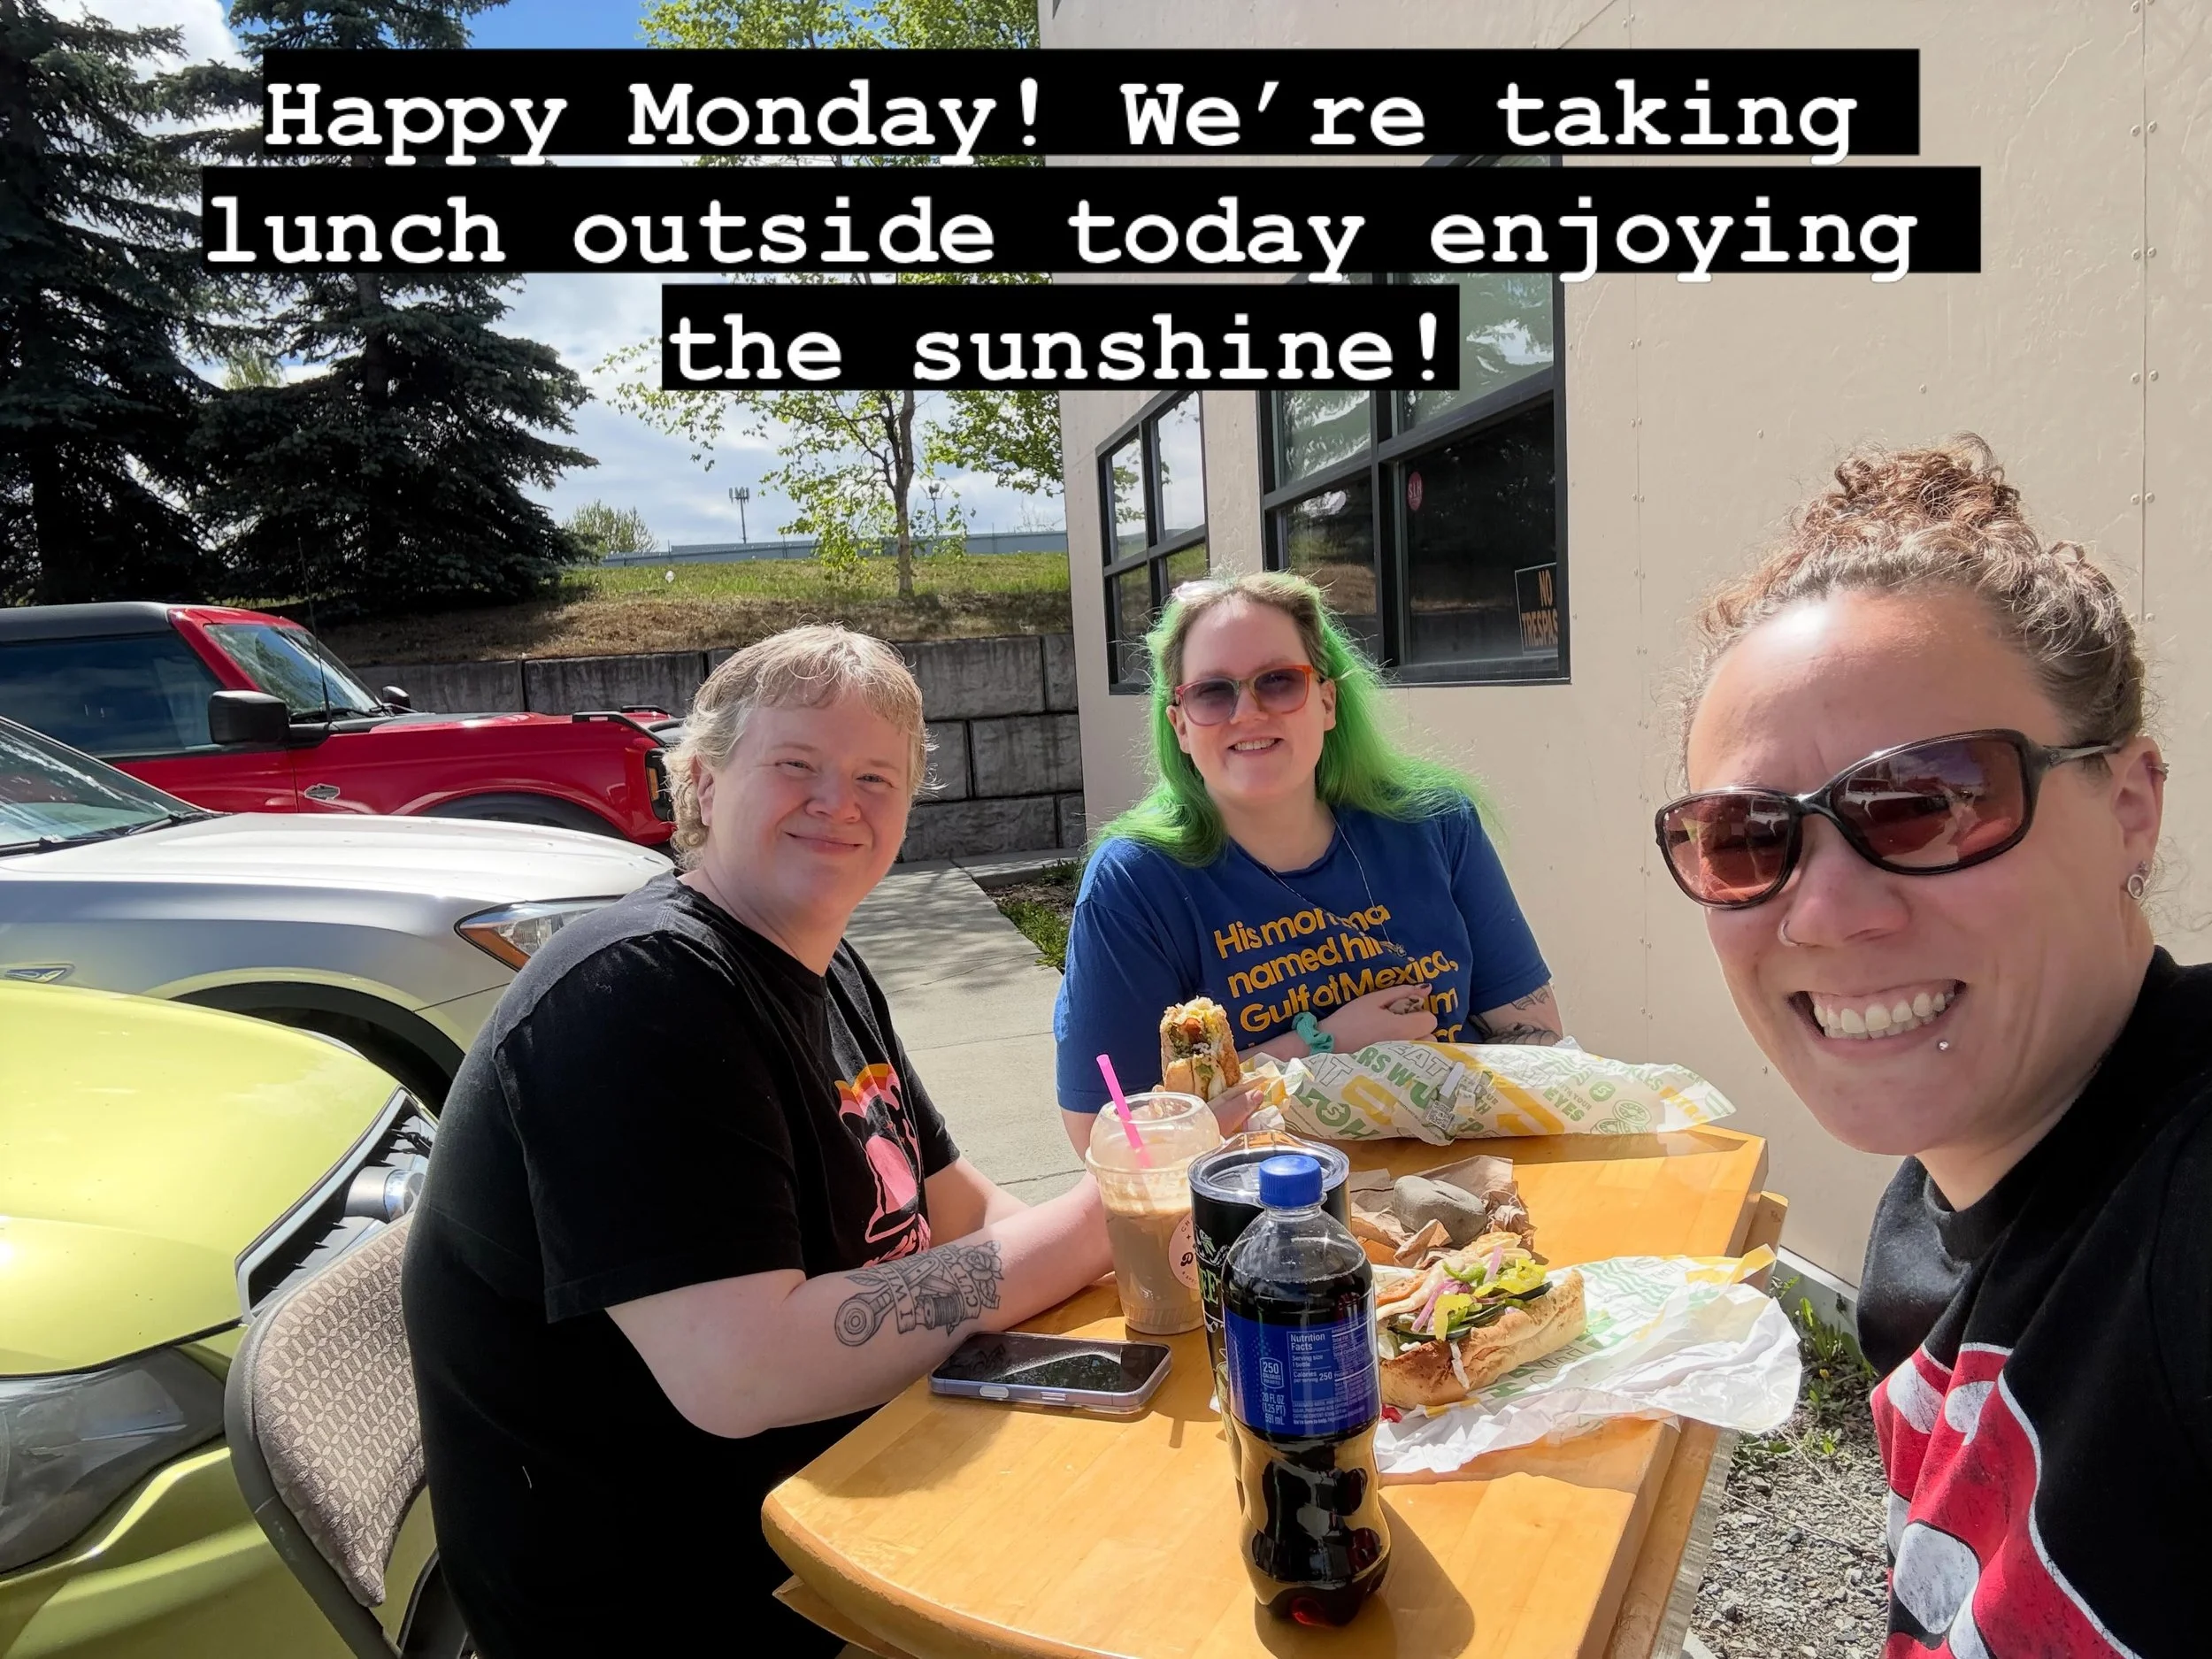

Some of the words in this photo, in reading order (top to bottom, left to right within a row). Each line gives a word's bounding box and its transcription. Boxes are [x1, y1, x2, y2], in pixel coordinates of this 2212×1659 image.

[1538, 569, 1553, 607] NO
[1213, 920, 1263, 960] His
[1227, 936, 1343, 999] named
[1240, 984, 1310, 1033] Gulf
[1312, 979, 1342, 1008] of
[1338, 950, 1460, 1002] Mexico,
[1349, 1047, 1392, 1073] RS
[1387, 1044, 1451, 1077] EAT
[1542, 1086, 1586, 1122] EYES
[1573, 1093, 1593, 1111] YOUR
[954, 1271, 979, 1307] CUT
[1290, 1333, 1325, 1343] Nutrition
[1291, 1342, 1313, 1351] Facts
[1263, 1361, 1279, 1374] 250
[1318, 1371, 1333, 1381] 250
[1262, 1391, 1270, 1402] 20
[1276, 1394, 1285, 1405] OZ
